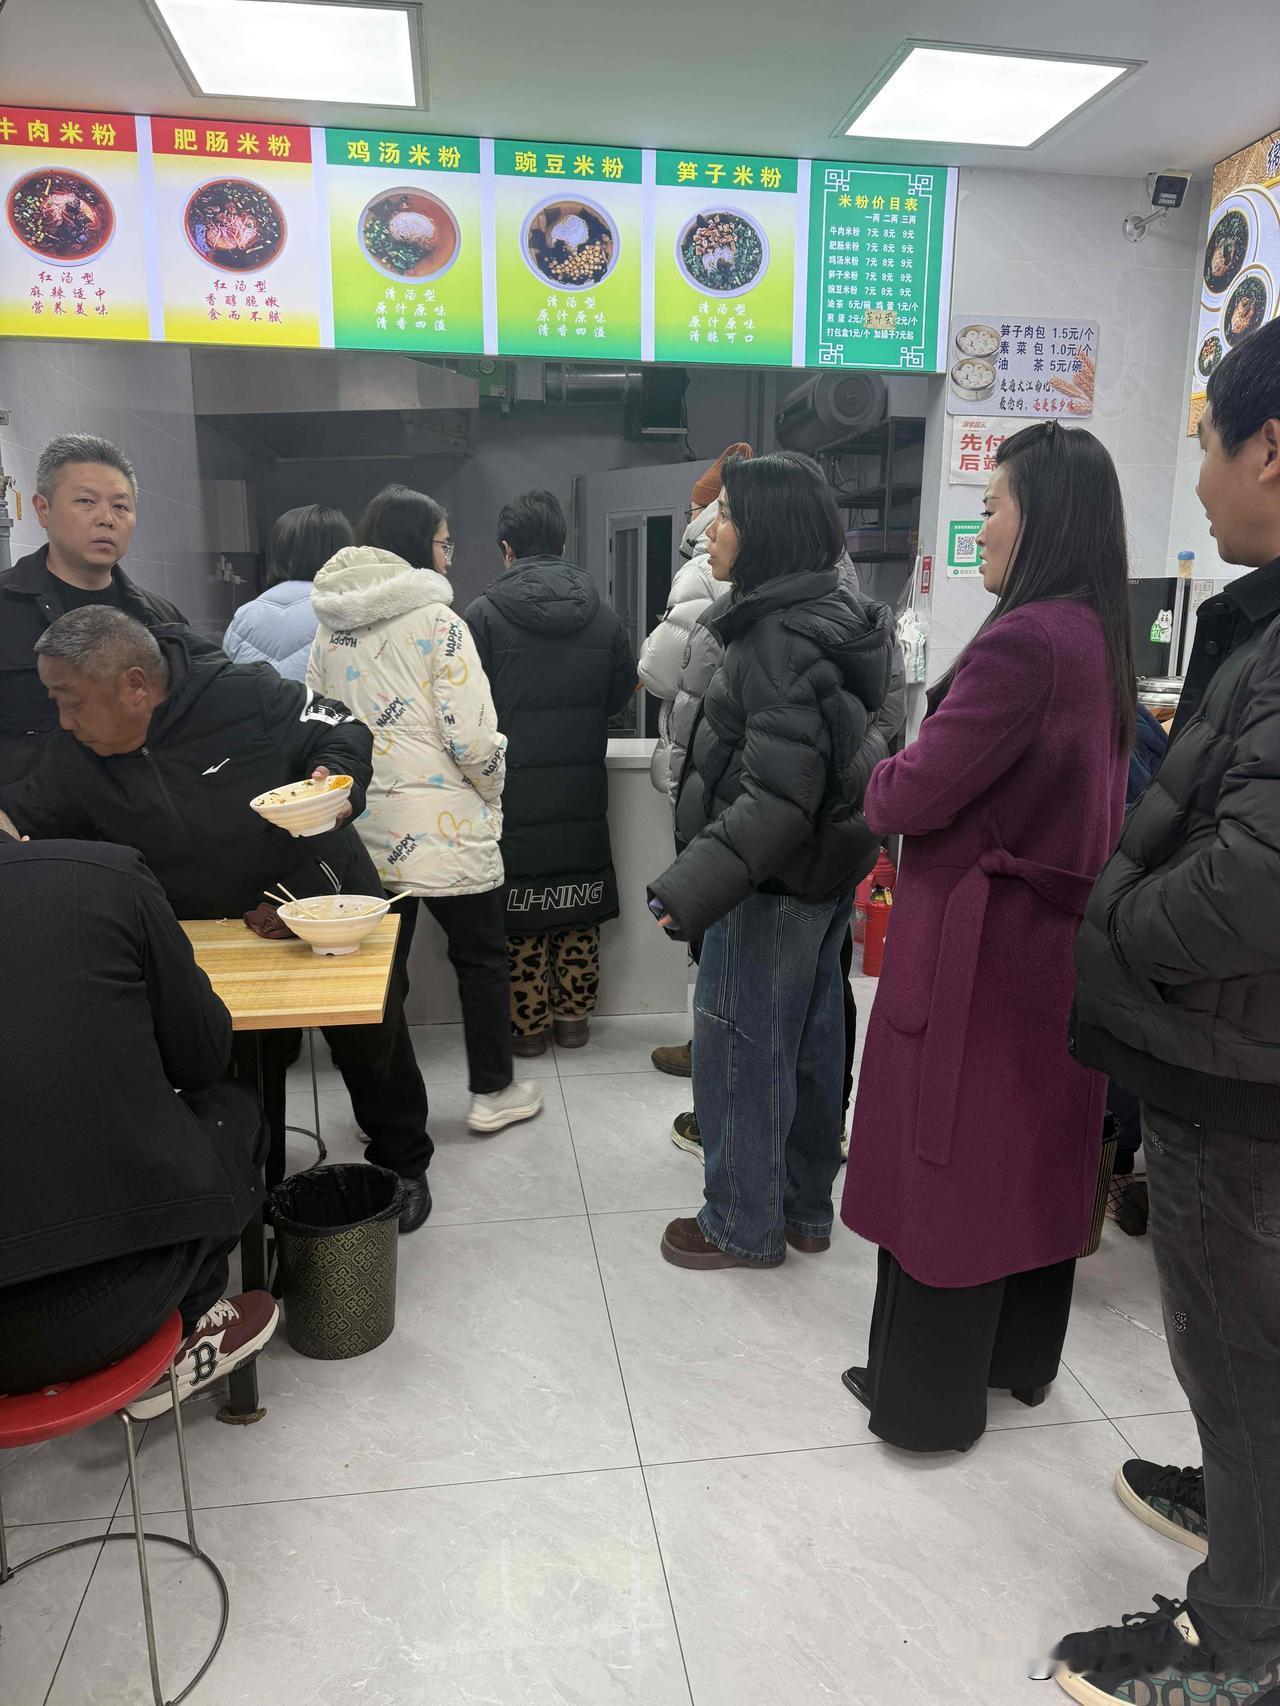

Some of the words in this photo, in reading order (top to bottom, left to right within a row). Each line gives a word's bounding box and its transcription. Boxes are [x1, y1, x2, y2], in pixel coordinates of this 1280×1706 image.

[0, 116, 116, 146] 牛肉米粉
[174, 128, 291, 157] 肥肠米粉
[347, 141, 461, 168] 鸡汤米粉
[515, 151, 624, 178] 豌豆米粉
[677, 161, 781, 188] 笋子米粉
[839, 194, 918, 212] 米粉价目表
[865, 213, 880, 223] 一两
[883, 214, 898, 224] 二两
[901, 215, 916, 225] 三两
[830, 226, 860, 237] 牛肉米粉
[867, 228, 879, 237] 7元
[883, 229, 896, 238] 8元
[902, 230, 915, 239] 9元
[829, 241, 860, 251] 肥肠米粉
[866, 242, 878, 252] 7元
[882, 243, 895, 253] 8元
[901, 244, 914, 254] 9元
[828, 255, 859, 266] 鸡汤米粉
[865, 257, 878, 267] 7元
[882, 258, 894, 267] 8元
[901, 259, 913, 268] 9元
[38, 271, 95, 285] 红汤型
[828, 270, 858, 280] 笋子米粉
[865, 272, 877, 281] 7元
[881, 272, 894, 282] 8元
[900, 273, 912, 282] 9元
[29, 285, 106, 301] 麻辣适中
[213, 279, 267, 293] 红汤型
[864, 286, 877, 296] 7元
[881, 287, 893, 296] 8元
[899, 287, 912, 297] 9元
[205, 293, 280, 307] 香醇脆嫩
[385, 287, 436, 302] 清汤型
[547, 294, 596, 309] 清汤型
[31, 300, 108, 316] 营养美味
[375, 301, 446, 317] 原汁原味
[699, 301, 746, 316] 清汤型
[897, 302, 919, 312] 1元/个
[208, 308, 282, 324] 食而不腻
[376, 316, 446, 331] 清香四溢
[537, 309, 606, 323] 原汁原味
[689, 315, 755, 330] 原汁原味
[896, 316, 919, 326] 2元/个
[537, 323, 606, 338] 清香四溢
[689, 329, 754, 343] 清脆可口
[1000, 324, 1045, 339] 笋子肉包
[1052, 327, 1094, 341] 1.5元/个
[999, 341, 1044, 355] 素菜包
[1051, 343, 1092, 357] 1.0元/个
[1050, 359, 1083, 373] 5元/碗
[329, 633, 358, 648] HAPPY
[445, 622, 459, 657] HAPPY
[376, 696, 404, 728] HAPPY
[387, 832, 416, 865] HAPPY
[506, 881, 604, 911] LI-NING
[187, 1341, 219, 1386] B
